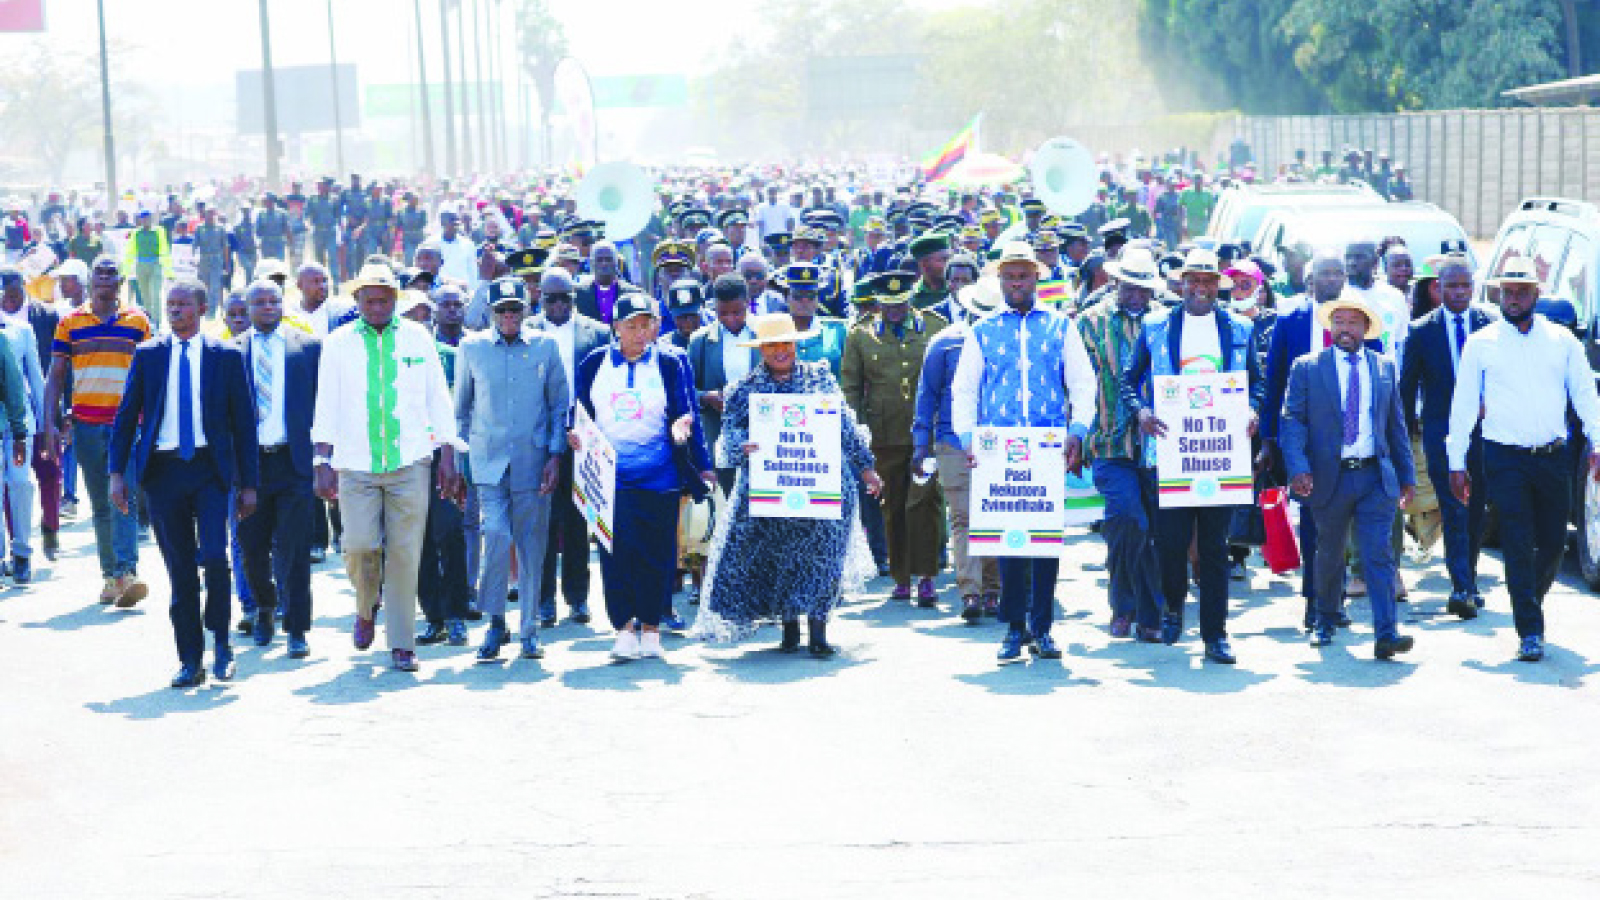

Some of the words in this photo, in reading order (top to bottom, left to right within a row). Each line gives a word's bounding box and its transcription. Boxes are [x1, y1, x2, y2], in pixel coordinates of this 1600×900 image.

[1182, 416, 1203, 433] No
[1206, 416, 1227, 433] To
[779, 431, 796, 443] No
[798, 431, 814, 443] To
[1179, 434, 1233, 453] Sexual
[776, 445, 805, 459] Drug
[763, 460, 829, 474] Substance
[1182, 457, 1231, 473] Abuse
[1005, 468, 1032, 482] Pasi
